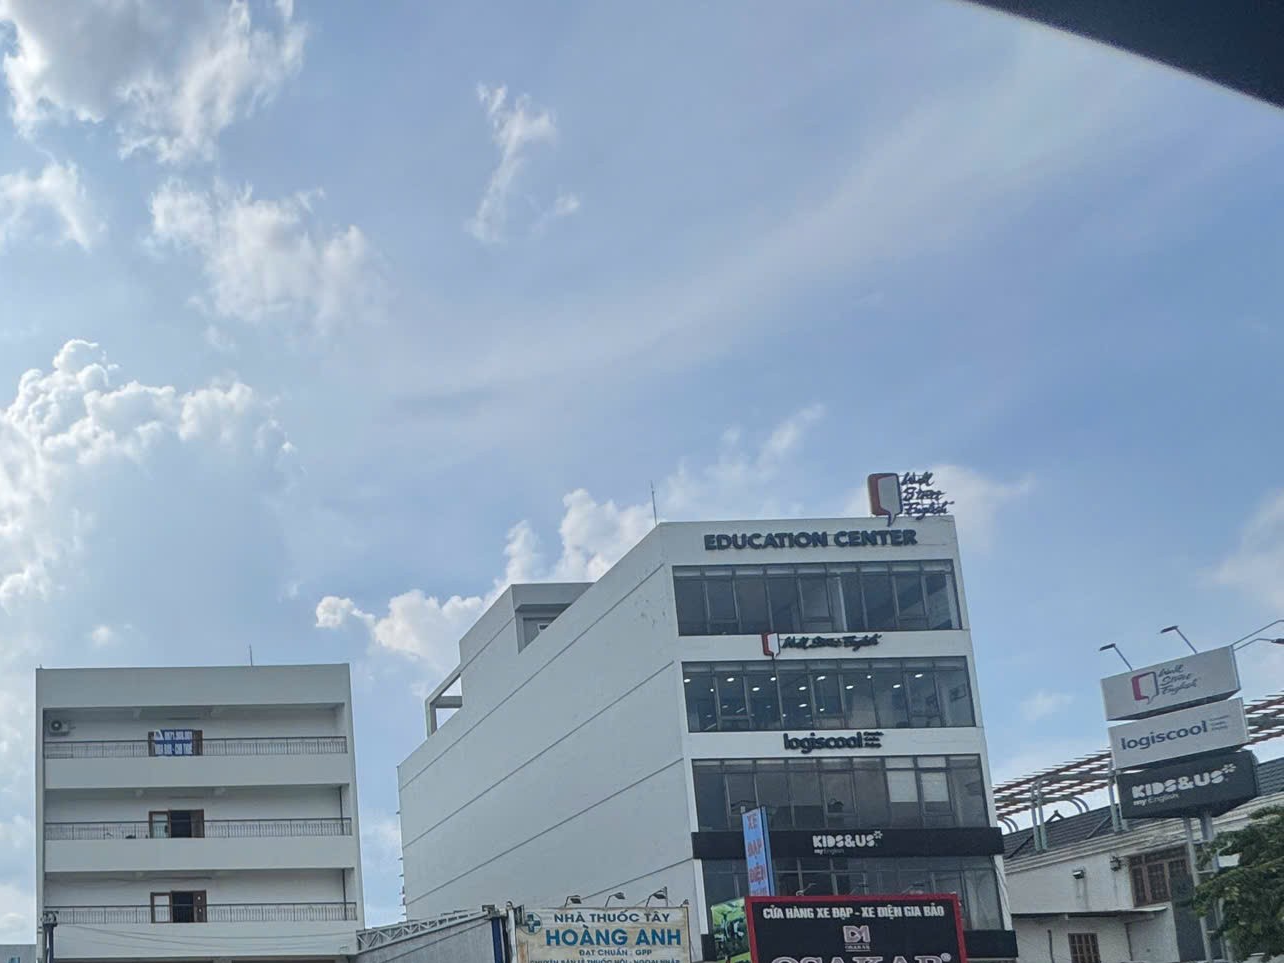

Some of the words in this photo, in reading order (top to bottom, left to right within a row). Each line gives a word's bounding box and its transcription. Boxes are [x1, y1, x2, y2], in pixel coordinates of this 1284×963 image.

[705, 531, 828, 551] EDUCATION
[834, 529, 918, 548] CENTER
[783, 731, 863, 754] logiscool
[1121, 720, 1208, 750] logiscool
[1131, 769, 1224, 799] KIDS&US
[812, 834, 875, 848] KIDS&US
[554, 911, 585, 923] NHÀ
[590, 909, 639, 923] THUỐC
[644, 910, 671, 922] TÂY
[763, 905, 784, 919] CỬA
[786, 904, 814, 919] HÀNG
[817, 907, 831, 918] XE
[832, 906, 854, 920] ĐẠP
[861, 906, 876, 918] XE
[877, 904, 902, 919] ĐIỆN
[904, 905, 922, 917] GIA
[923, 902, 944, 917] BẢO
[546, 924, 628, 946] HOÀNG
[636, 928, 682, 946] ANH
[635, 948, 652, 957] GPP
